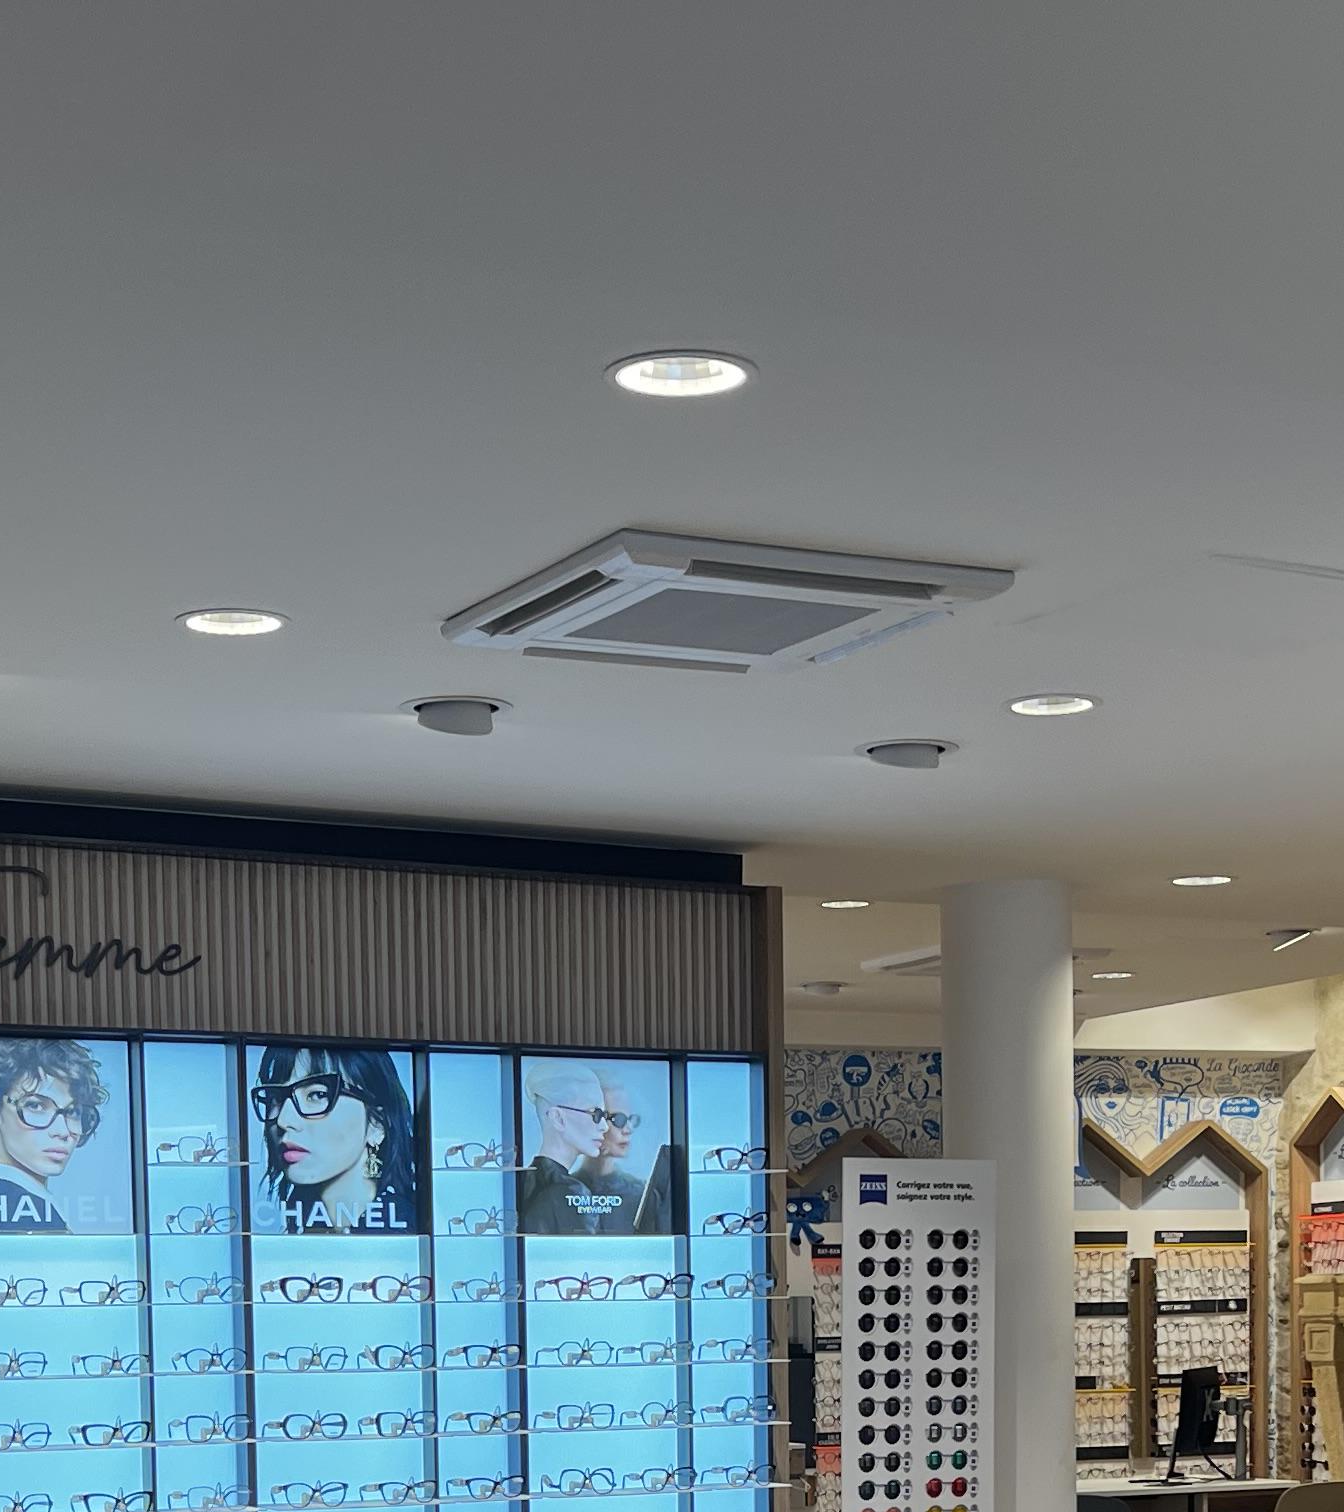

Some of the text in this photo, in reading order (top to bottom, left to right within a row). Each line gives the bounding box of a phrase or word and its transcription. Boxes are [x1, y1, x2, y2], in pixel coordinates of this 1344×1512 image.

[860, 1182, 887, 1191] ZEISS
[896, 1181, 930, 1191] Corrigez
[1162, 1174, 1219, 1190] La collection
[565, 1195, 623, 1206] TOM FORD
[896, 1193, 928, 1202] soignez
[954, 1193, 975, 1203] style.
[253, 1201, 407, 1229] CHANEL
[577, 1206, 612, 1214] EYEWEAR
